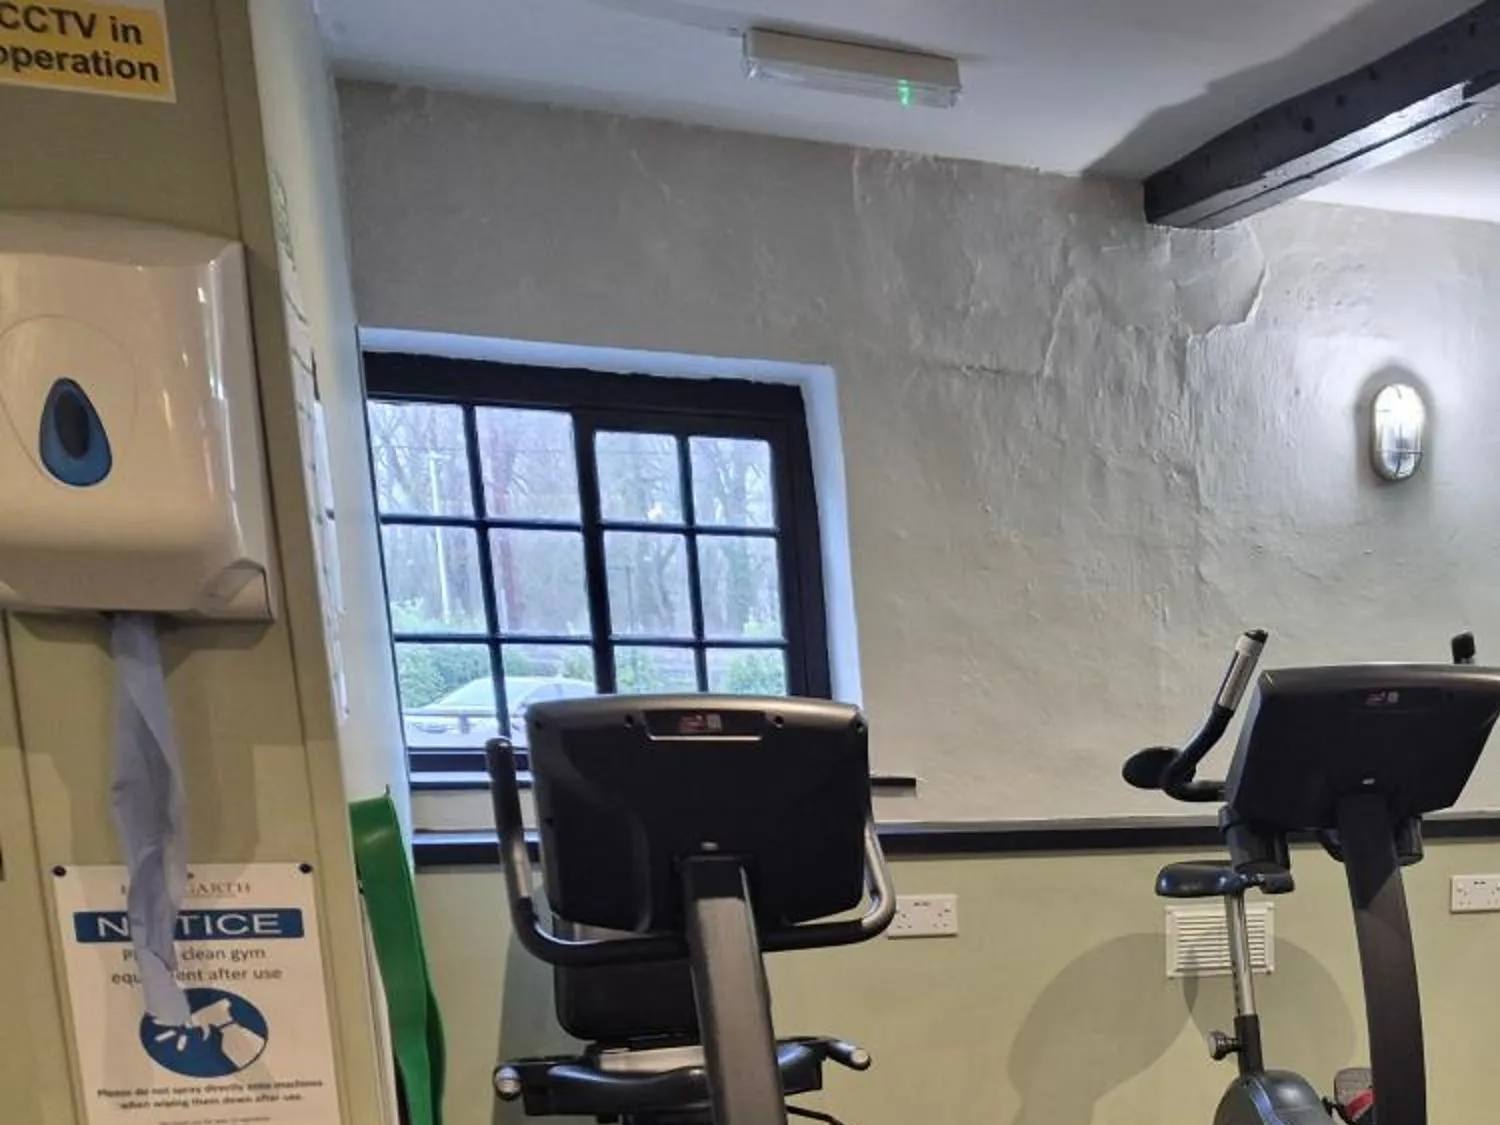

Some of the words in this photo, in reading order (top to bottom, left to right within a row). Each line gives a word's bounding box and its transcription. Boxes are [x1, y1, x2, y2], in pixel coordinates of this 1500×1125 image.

[0, 2, 97, 39] CCTV
[109, 15, 143, 45] in
[97, 912, 283, 938] NTICE
[181, 947, 226, 961] clean
[231, 948, 266, 962] gym
[208, 967, 247, 981] after
[253, 969, 283, 979] use
